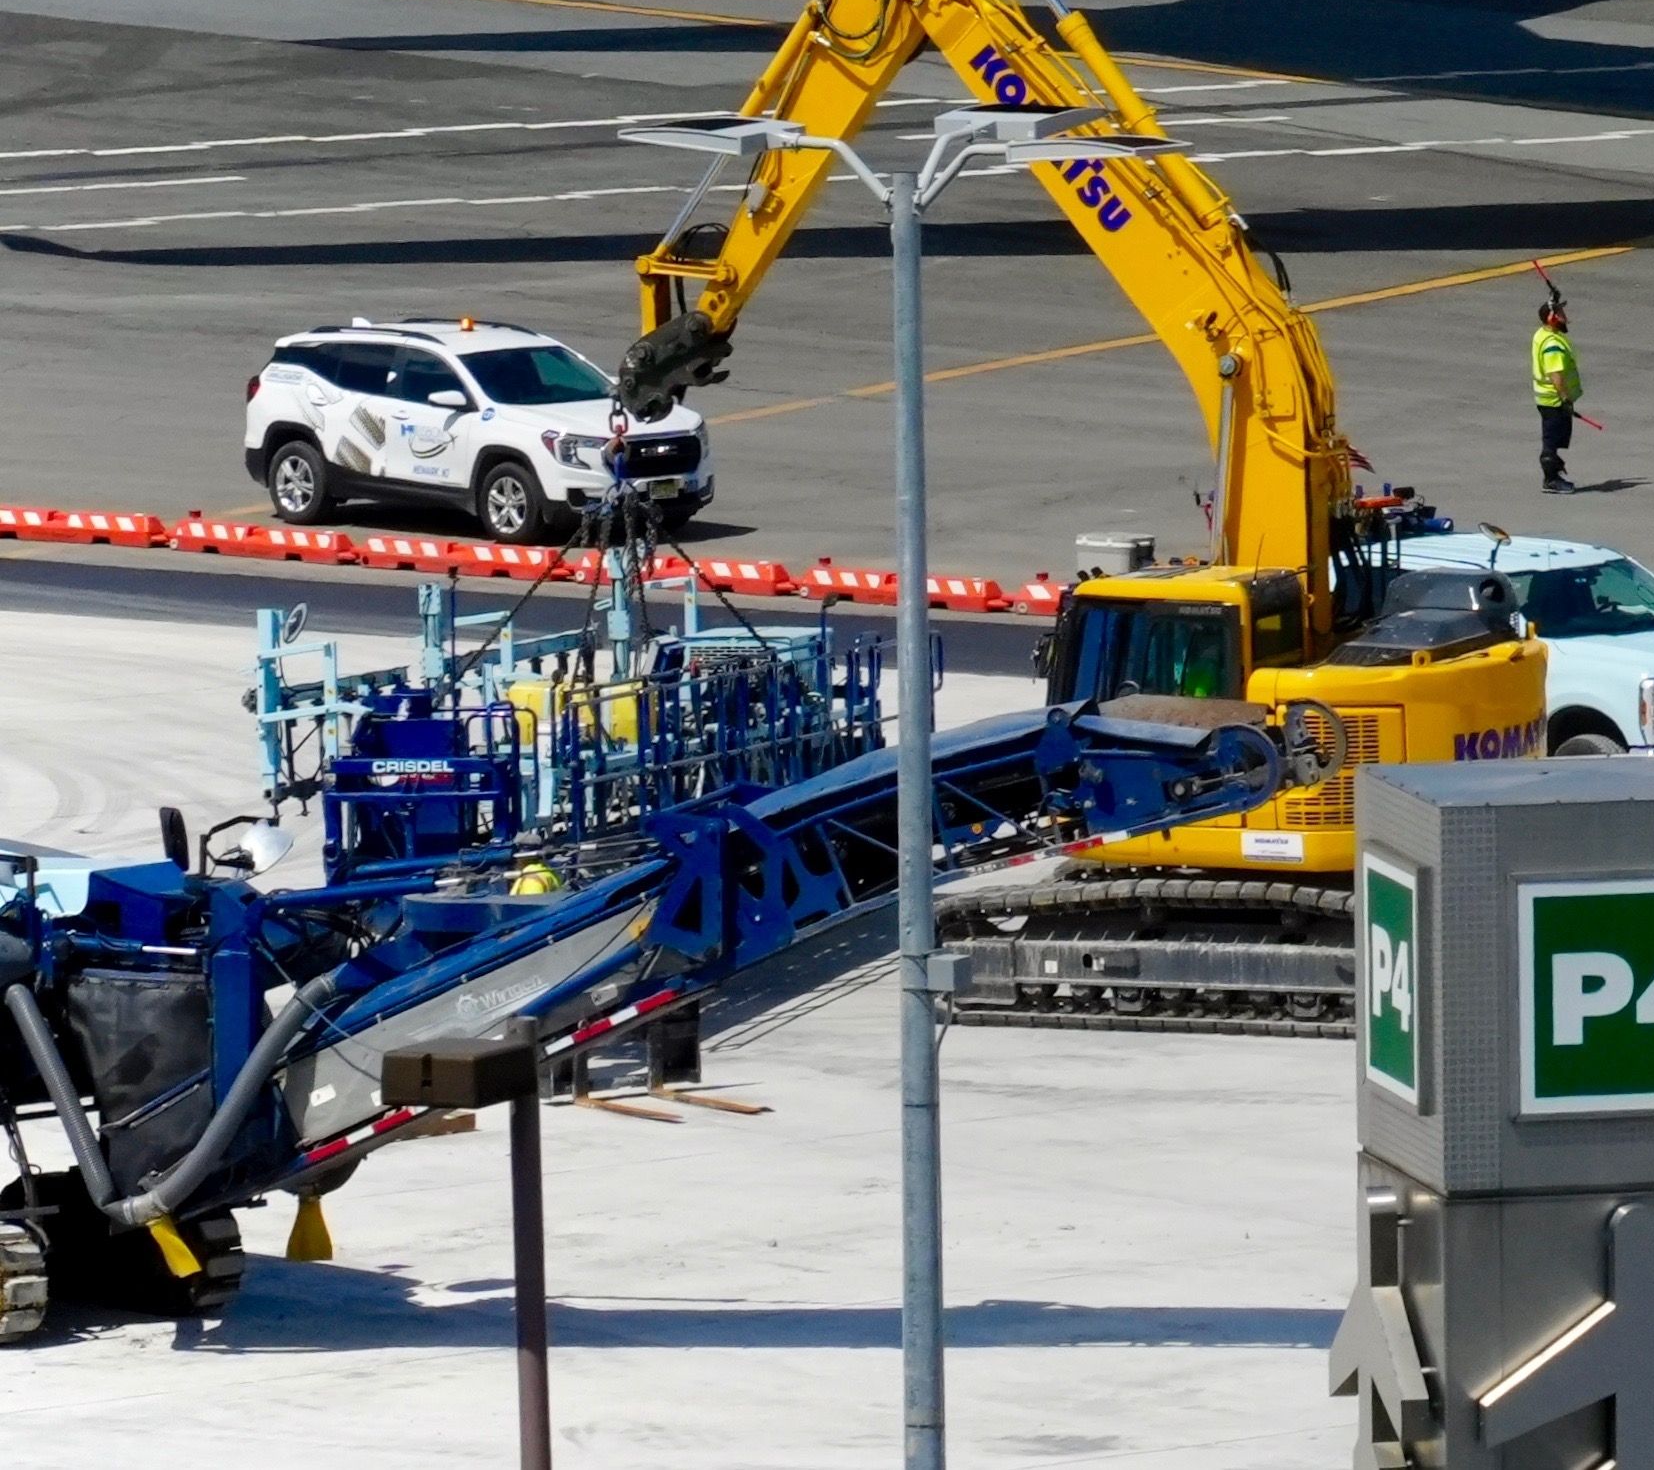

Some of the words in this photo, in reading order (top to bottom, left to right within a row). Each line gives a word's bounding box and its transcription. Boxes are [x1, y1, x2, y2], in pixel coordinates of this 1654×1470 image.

[970, 45, 1132, 234] KOTSU
[371, 760, 456, 774] CRISDEL
[1371, 922, 1410, 1034] P4
